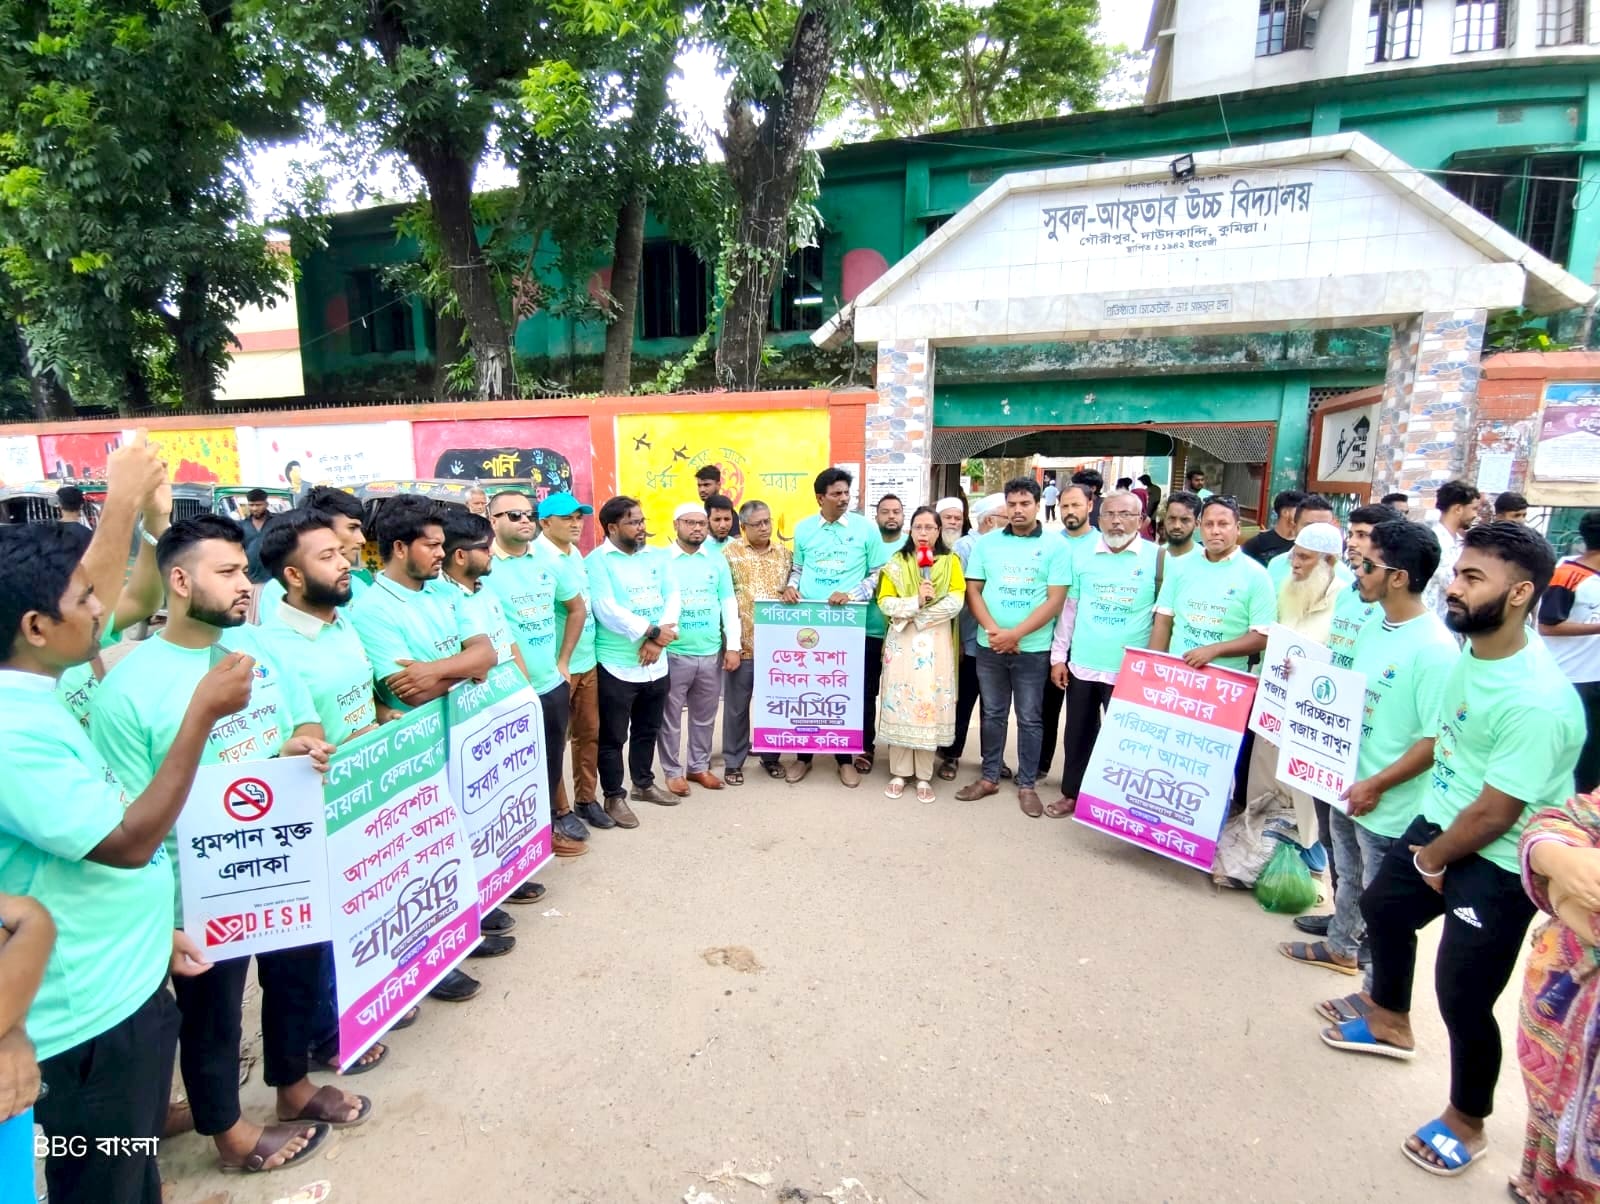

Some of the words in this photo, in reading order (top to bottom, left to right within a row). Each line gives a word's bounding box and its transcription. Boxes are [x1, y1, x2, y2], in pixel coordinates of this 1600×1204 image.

[1184, 184, 1224, 219] উচ্চ
[1230, 179, 1313, 218] বিদ্যালয়
[1080, 231, 1136, 247] গৌরীপুর,
[1141, 225, 1213, 241] দাউদকান্দি,
[1218, 222, 1258, 237] কুমিল্লা
[761, 604, 812, 623] পরিবেশ
[817, 604, 858, 624] বাঁচাই
[768, 667, 810, 688] নিধন
[815, 669, 849, 688] করি
[772, 649, 807, 669] ডেঙ্গু
[812, 650, 848, 666] মশা
[1131, 659, 1146, 676] এ
[1154, 663, 1211, 691] আমার
[1143, 686, 1217, 720] অঙ্গীকার
[1296, 700, 1352, 732] পরিচ্ছন্নতা
[329, 736, 390, 785] যেখানে
[394, 711, 441, 750] সেখানে
[471, 735, 492, 762] শুভ
[493, 713, 530, 747] কাজে
[763, 731, 810, 747] আসিফ
[812, 731, 851, 747] কবির
[1113, 711, 1172, 745] পরিচ্ছন্ন
[1176, 729, 1233, 761] রাখবো
[1289, 719, 1318, 743] বজায়
[1321, 731, 1352, 756] রাখুন
[467, 763, 499, 799] সবার
[503, 741, 536, 772] পাশে
[1119, 738, 1152, 760] দেশ
[1158, 748, 1211, 778] আমার
[324, 779, 373, 821] ময়লা
[380, 746, 435, 793] ফেলবো
[364, 783, 440, 839] পরিবেশটা
[191, 828, 265, 859] ধুমপান
[271, 821, 314, 848] মুক্ত
[1090, 804, 1147, 836] আসিফ
[1150, 829, 1200, 857] কবির
[218, 853, 290, 881] এলাকা
[341, 858, 411, 917] আমাদের
[414, 831, 456, 865] সবার
[516, 840, 544, 872] কবির
[245, 903, 312, 933] DESH
[356, 962, 420, 1026] আসিফ
[424, 922, 468, 968] কবির
